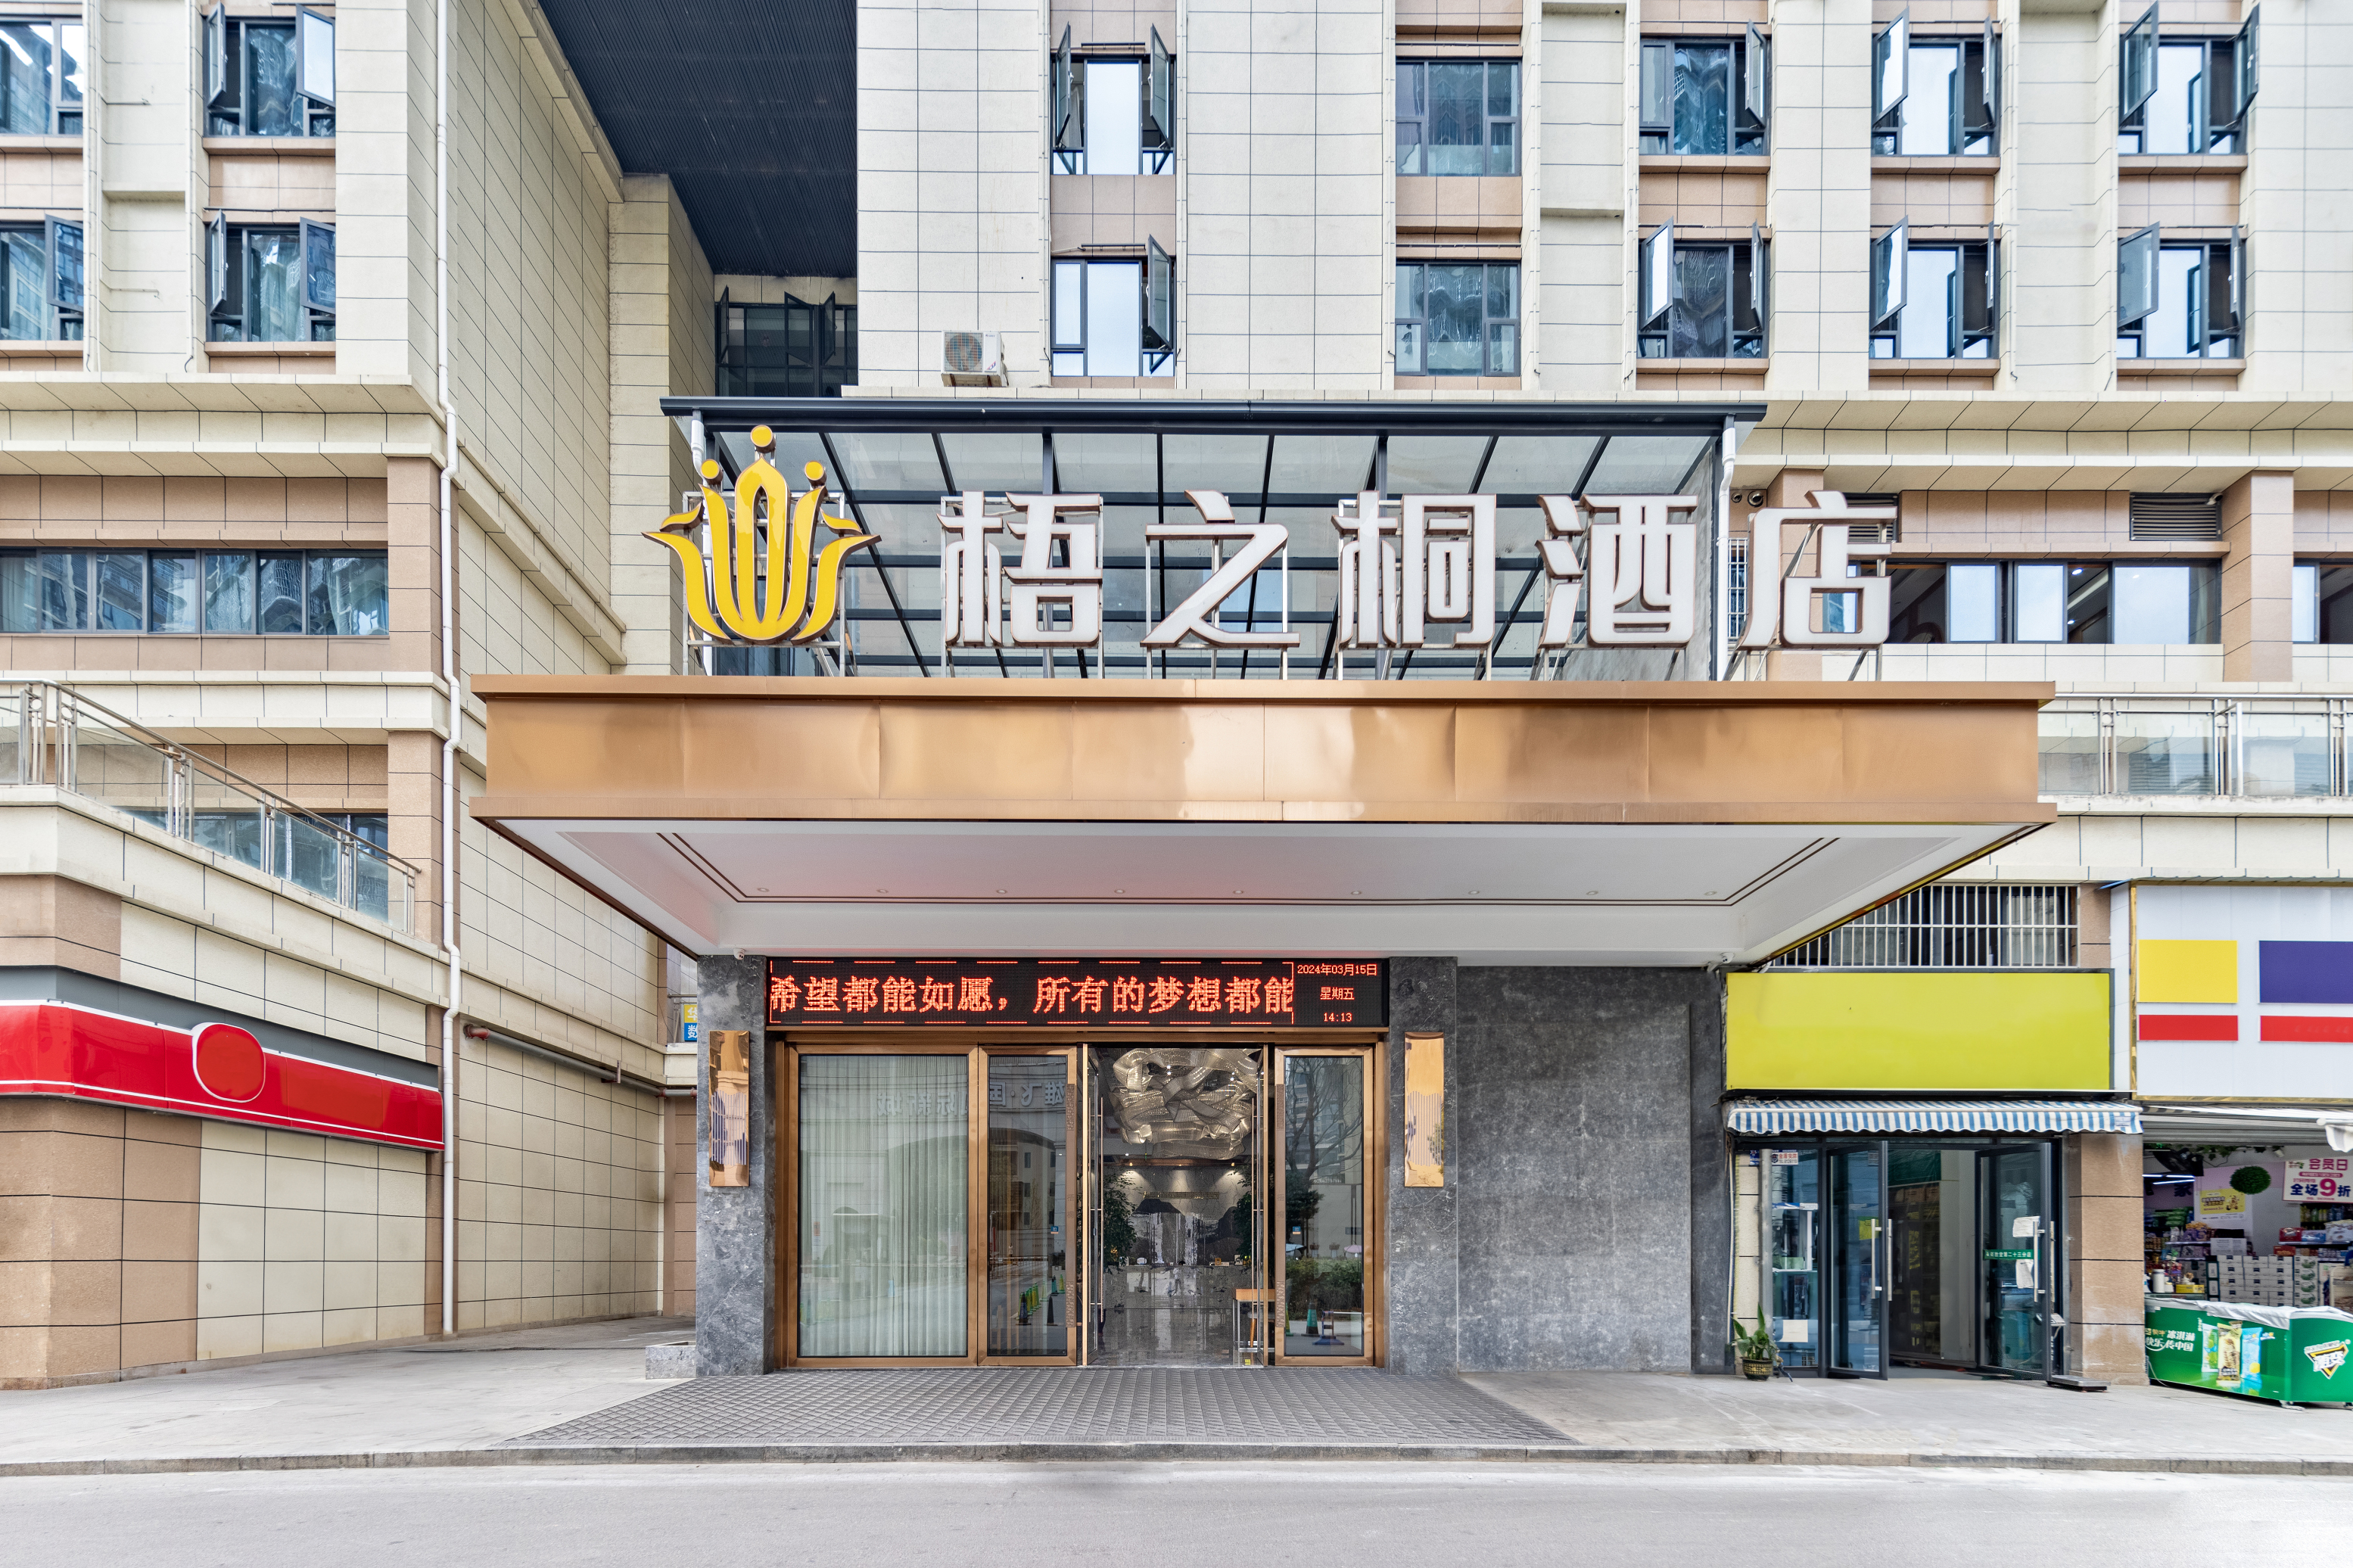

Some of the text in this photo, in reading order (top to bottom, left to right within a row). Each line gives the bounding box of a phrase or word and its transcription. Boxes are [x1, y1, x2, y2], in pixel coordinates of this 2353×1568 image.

[937, 490, 1898, 651] 梧之桐酒店
[1297, 963, 1377, 976] 2024年03月15日
[1320, 986, 1355, 1000] 星期五
[1324, 1012, 1352, 1022] 14:13
[2309, 1158, 2348, 1171] 会员日
[2290, 1178, 2351, 1197] 全场9折
